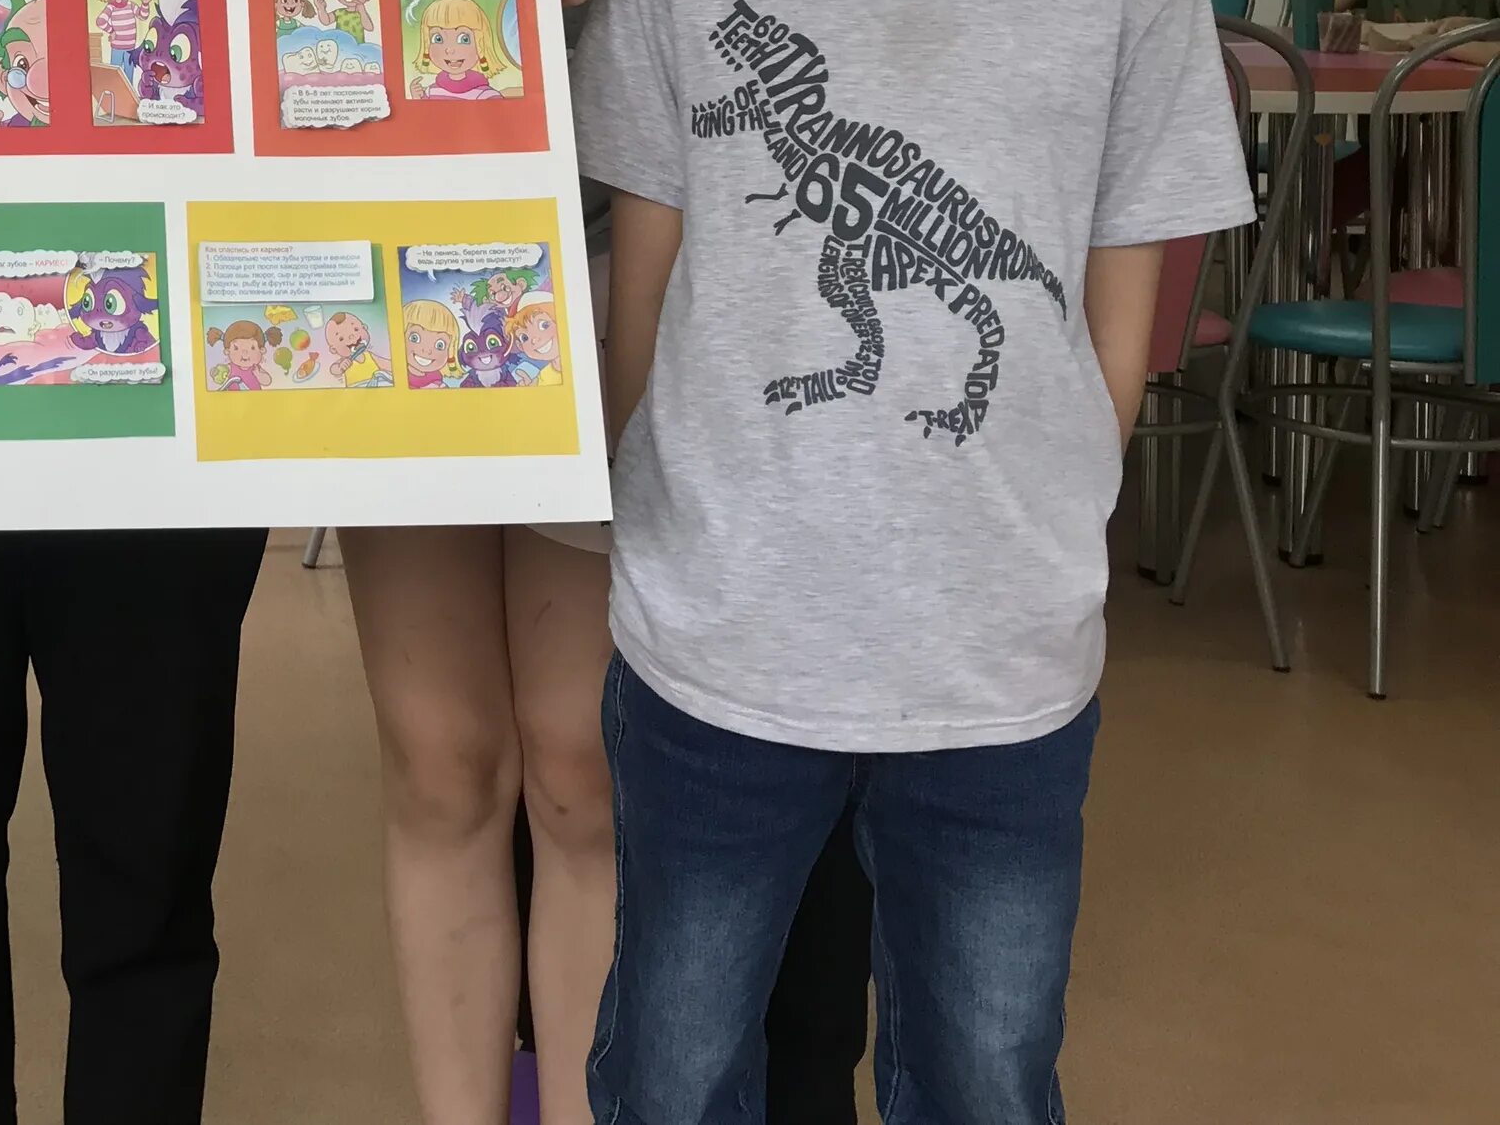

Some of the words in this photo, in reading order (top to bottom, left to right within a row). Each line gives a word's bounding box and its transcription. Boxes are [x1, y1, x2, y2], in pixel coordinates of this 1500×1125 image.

[716, 0, 790, 71] TEETH
[753, 15, 790, 44] 60
[734, 79, 761, 111] OF
[691, 100, 735, 138] KING
[736, 98, 781, 132] THE
[758, 33, 1001, 250] TYRANNOSAURUS
[763, 127, 808, 182] LAND
[796, 152, 890, 242] 65
[877, 187, 995, 280] MILLION
[826, 293, 854, 308] OF
[867, 318, 885, 358] GROW
[872, 234, 960, 301] APEX
[948, 284, 1005, 432] PREDATOR
[801, 369, 847, 406] TALL
